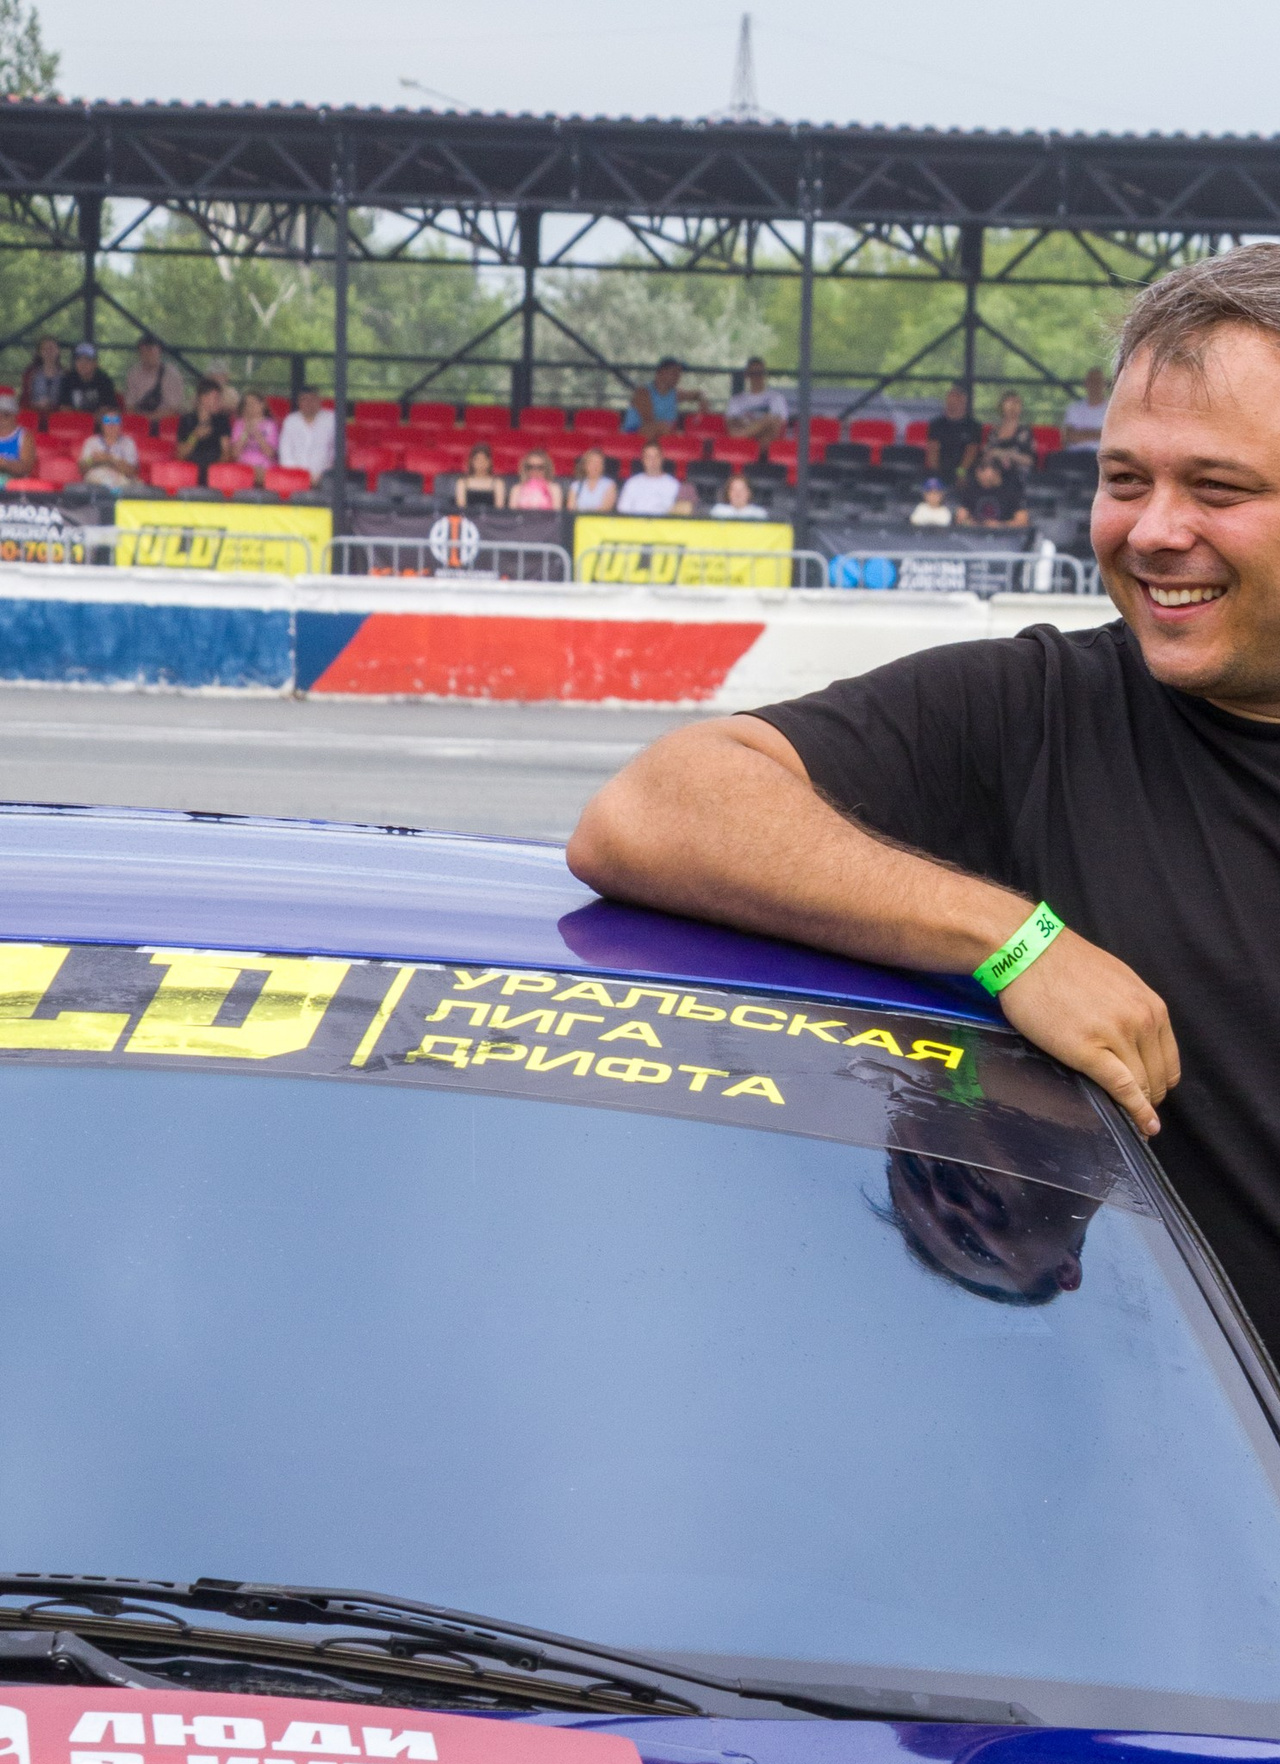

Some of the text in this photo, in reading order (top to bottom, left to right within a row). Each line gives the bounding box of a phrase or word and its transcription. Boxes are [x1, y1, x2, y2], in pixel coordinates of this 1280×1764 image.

[991, 939, 1028, 978] ПИЛОТ
[425, 999, 662, 1048] ЛИГА
[453, 971, 965, 1070] УРАЛЬСКАЯ
[404, 1034, 786, 1105] ДРИФТА
[69, 1711, 438, 1761] ЛЮДИ
